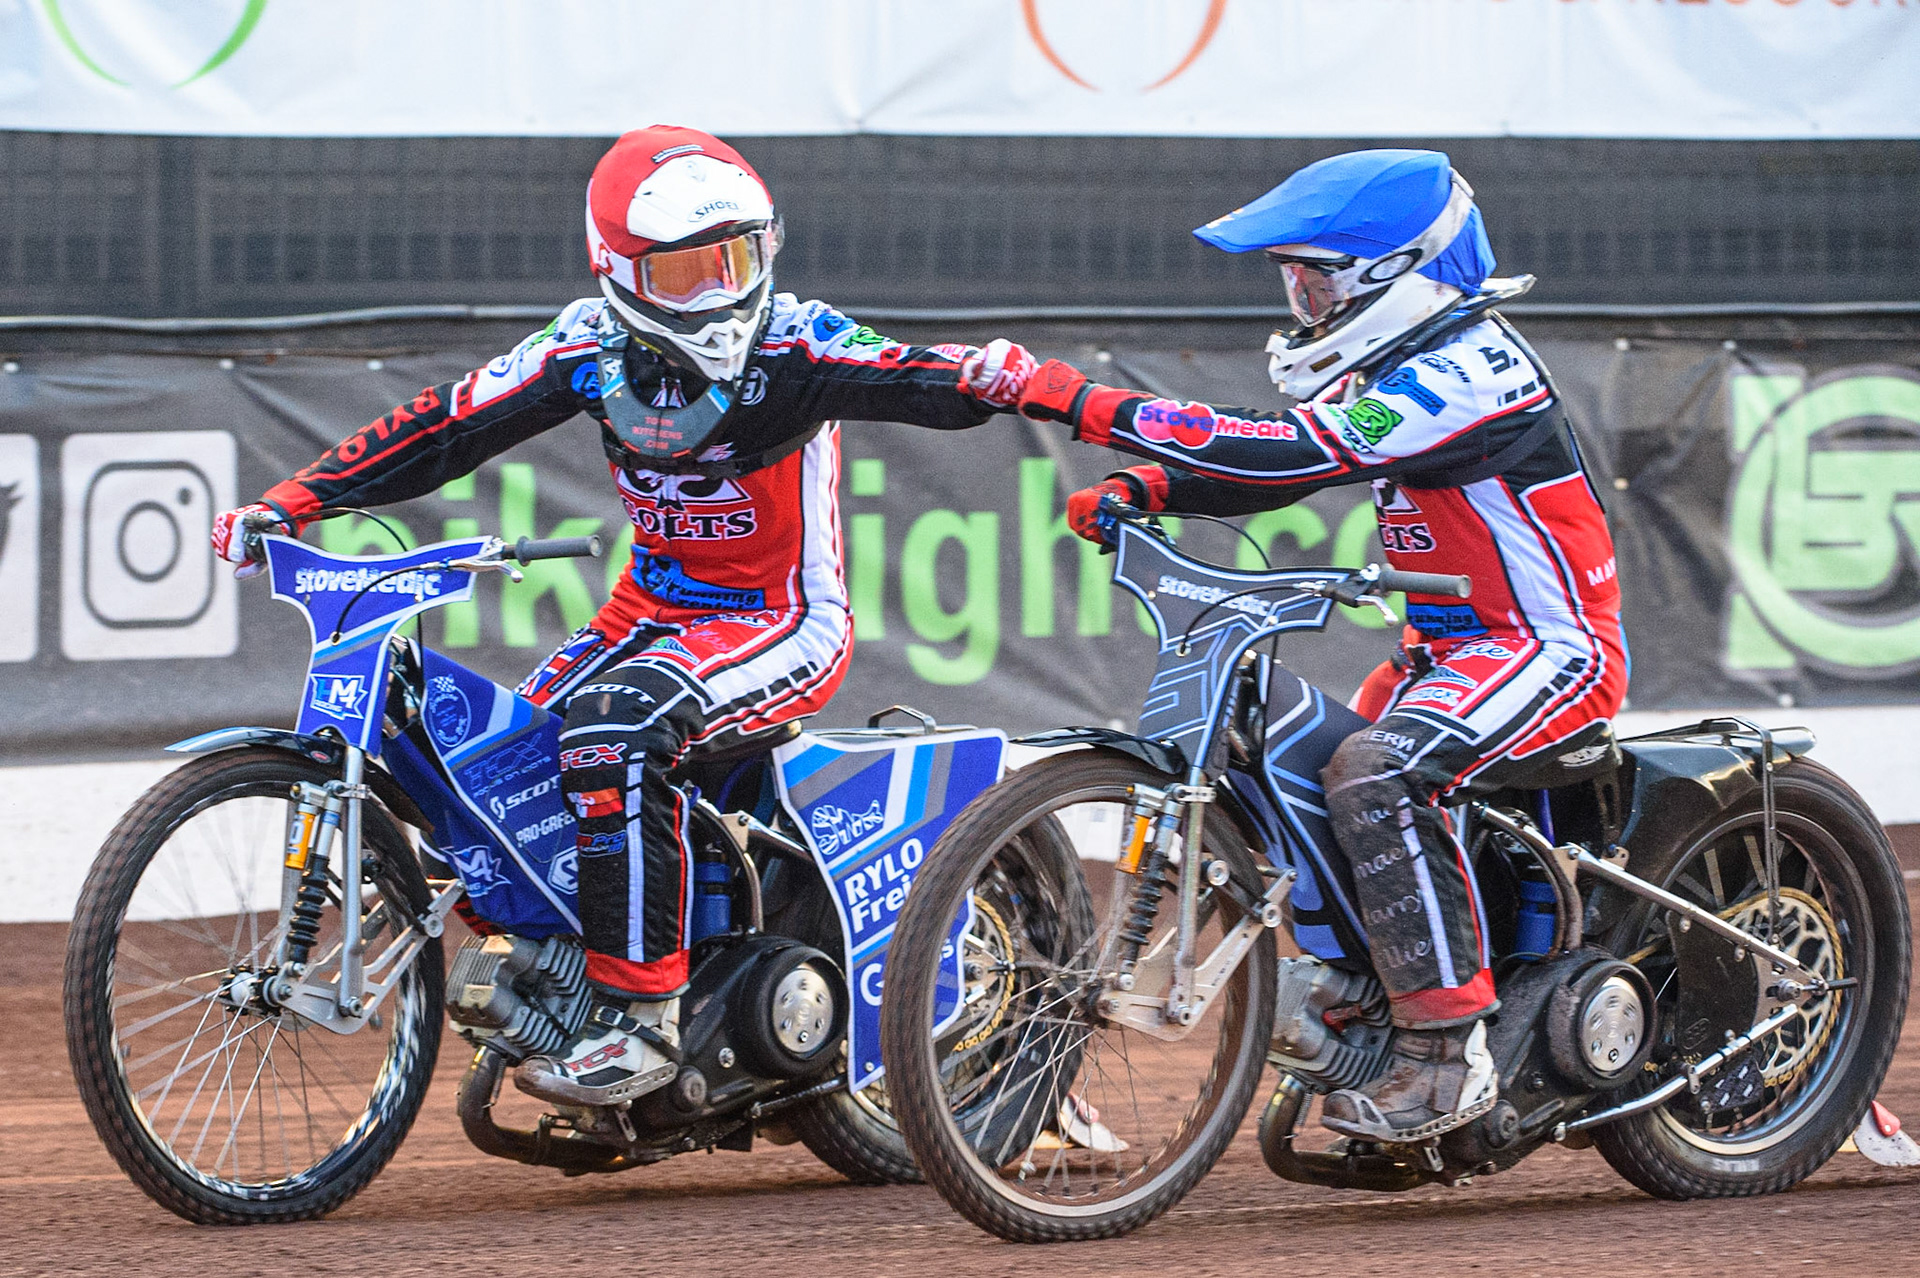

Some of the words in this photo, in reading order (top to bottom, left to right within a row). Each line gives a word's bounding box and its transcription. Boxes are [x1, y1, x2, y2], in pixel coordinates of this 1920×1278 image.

[694, 200, 740, 219] SHOEI
[573, 682, 657, 704] SCOTT
[559, 742, 628, 772] TCX
[843, 836, 924, 906] RYLO
[566, 1037, 629, 1073] TCX
